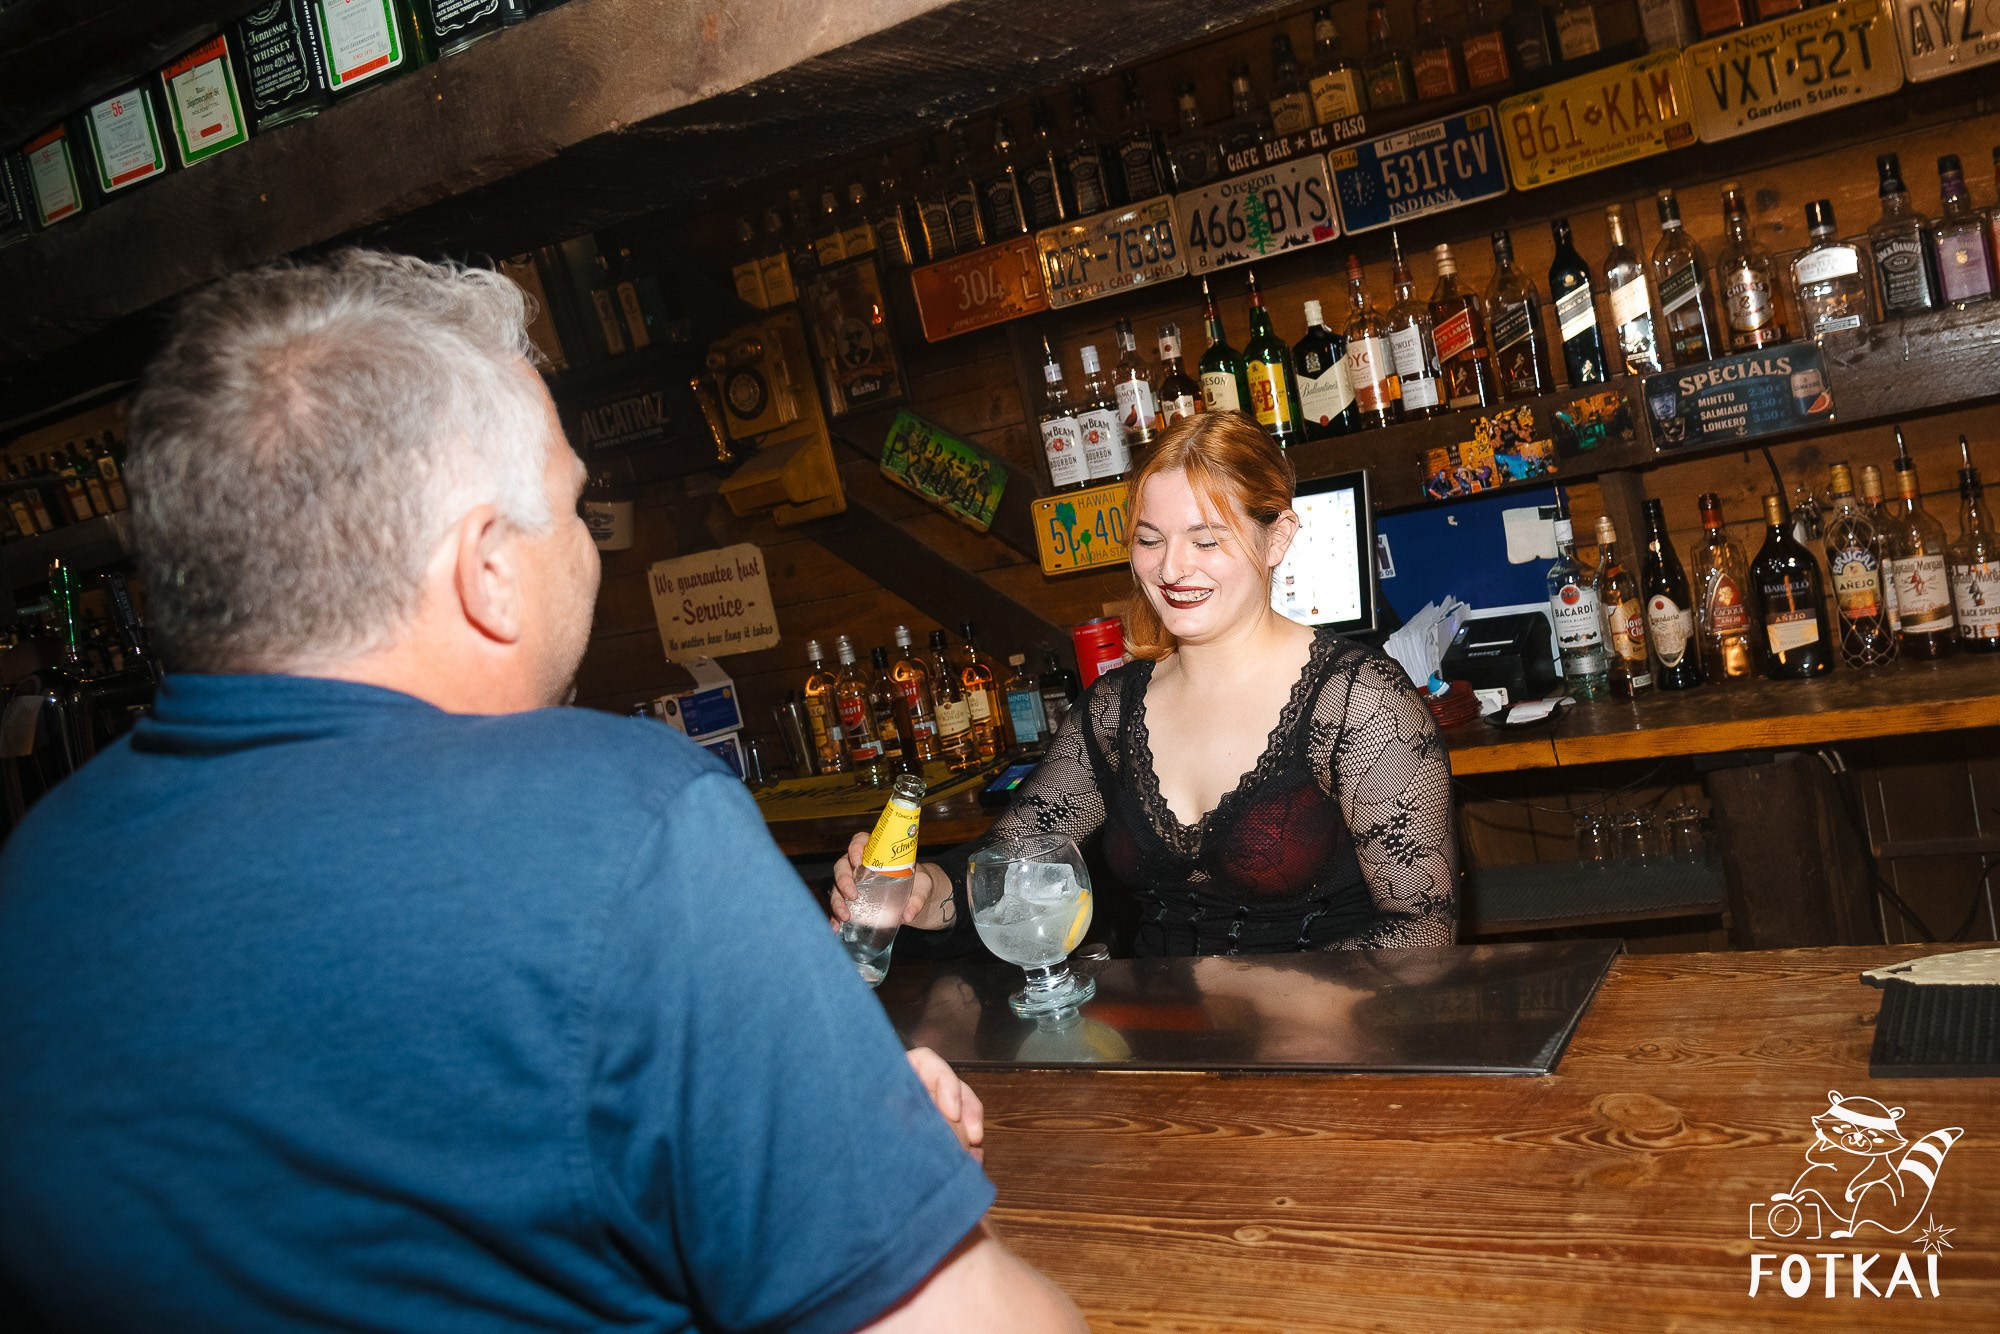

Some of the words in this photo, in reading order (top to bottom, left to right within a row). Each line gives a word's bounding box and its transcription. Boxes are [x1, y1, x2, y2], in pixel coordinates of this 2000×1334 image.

[248, 21, 288, 46] Tennessee
[1735, 32, 1775, 50] New
[1780, 16, 1834, 43] Jersey
[253, 39, 291, 63] WHISKEY
[1706, 47, 1779, 111] VXT
[1796, 20, 1872, 86] 52T
[110, 100, 124, 118] 56
[1747, 98, 1801, 121] Garden
[1806, 84, 1849, 103] State
[1512, 98, 1584, 160] 861
[1226, 146, 1260, 172] CAFE
[1264, 138, 1292, 162] BAR
[1310, 127, 1328, 148] EL
[1332, 115, 1366, 142] PASO
[1381, 132, 1488, 200] 531FCV
[1220, 173, 1277, 198] Oregon
[1388, 187, 1459, 217] INDIANA
[1189, 199, 1247, 253] 466
[1262, 177, 1328, 235] BYS
[1762, 330, 1772, 340] 12
[1518, 380, 1526, 388] 12
[1678, 357, 1792, 396] SPECIALS
[1698, 392, 1735, 408] MINTTU
[1700, 402, 1748, 421] SALMIAKKI
[582, 391, 670, 445] ALCATRAZ
[1088, 418, 1110, 430] BEAM
[1702, 417, 1746, 433] LONKERO
[1052, 426, 1075, 439] BEAM
[1077, 492, 1116, 510] HAWAII
[1080, 550, 1108, 562] ALOHA
[1832, 549, 1878, 576] BRUGAL
[654, 573, 674, 596] We
[678, 566, 734, 596] guarantee
[735, 556, 762, 582] fast
[1839, 578, 1875, 592] AÑEJO
[682, 594, 745, 626] Service
[1554, 600, 1594, 619] BACARDÍ
[1775, 612, 1806, 624] AÑEJO
[680, 635, 705, 650] matter
[707, 632, 722, 646] how
[725, 628, 742, 642] long
[752, 622, 774, 638] takes
[895, 812, 913, 820] TONICA
